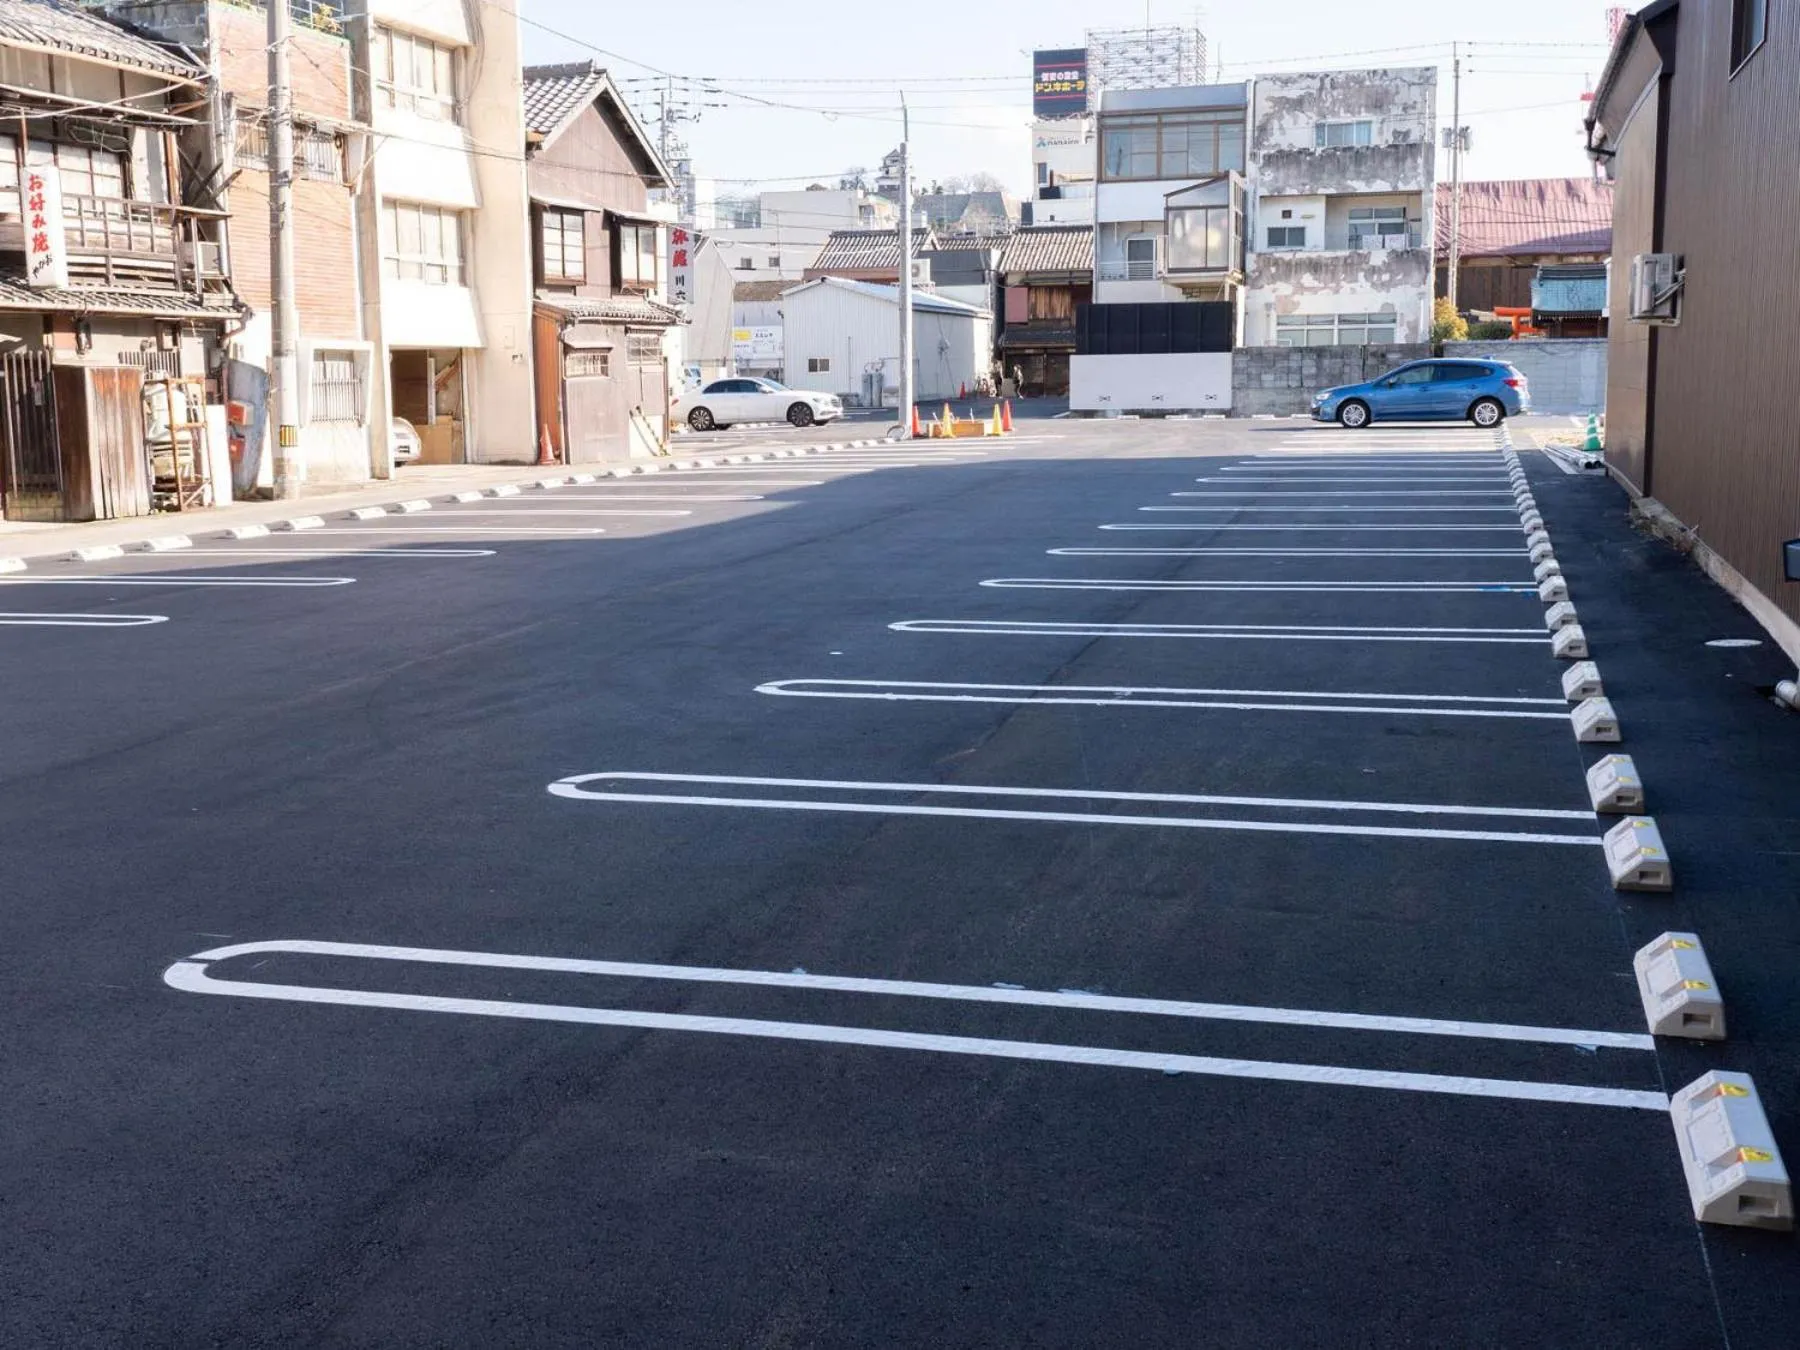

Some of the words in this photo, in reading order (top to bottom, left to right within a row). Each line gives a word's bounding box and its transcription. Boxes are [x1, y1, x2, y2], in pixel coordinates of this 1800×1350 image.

[29, 174, 49, 253] お好み焼
[675, 274, 686, 300] 川六
